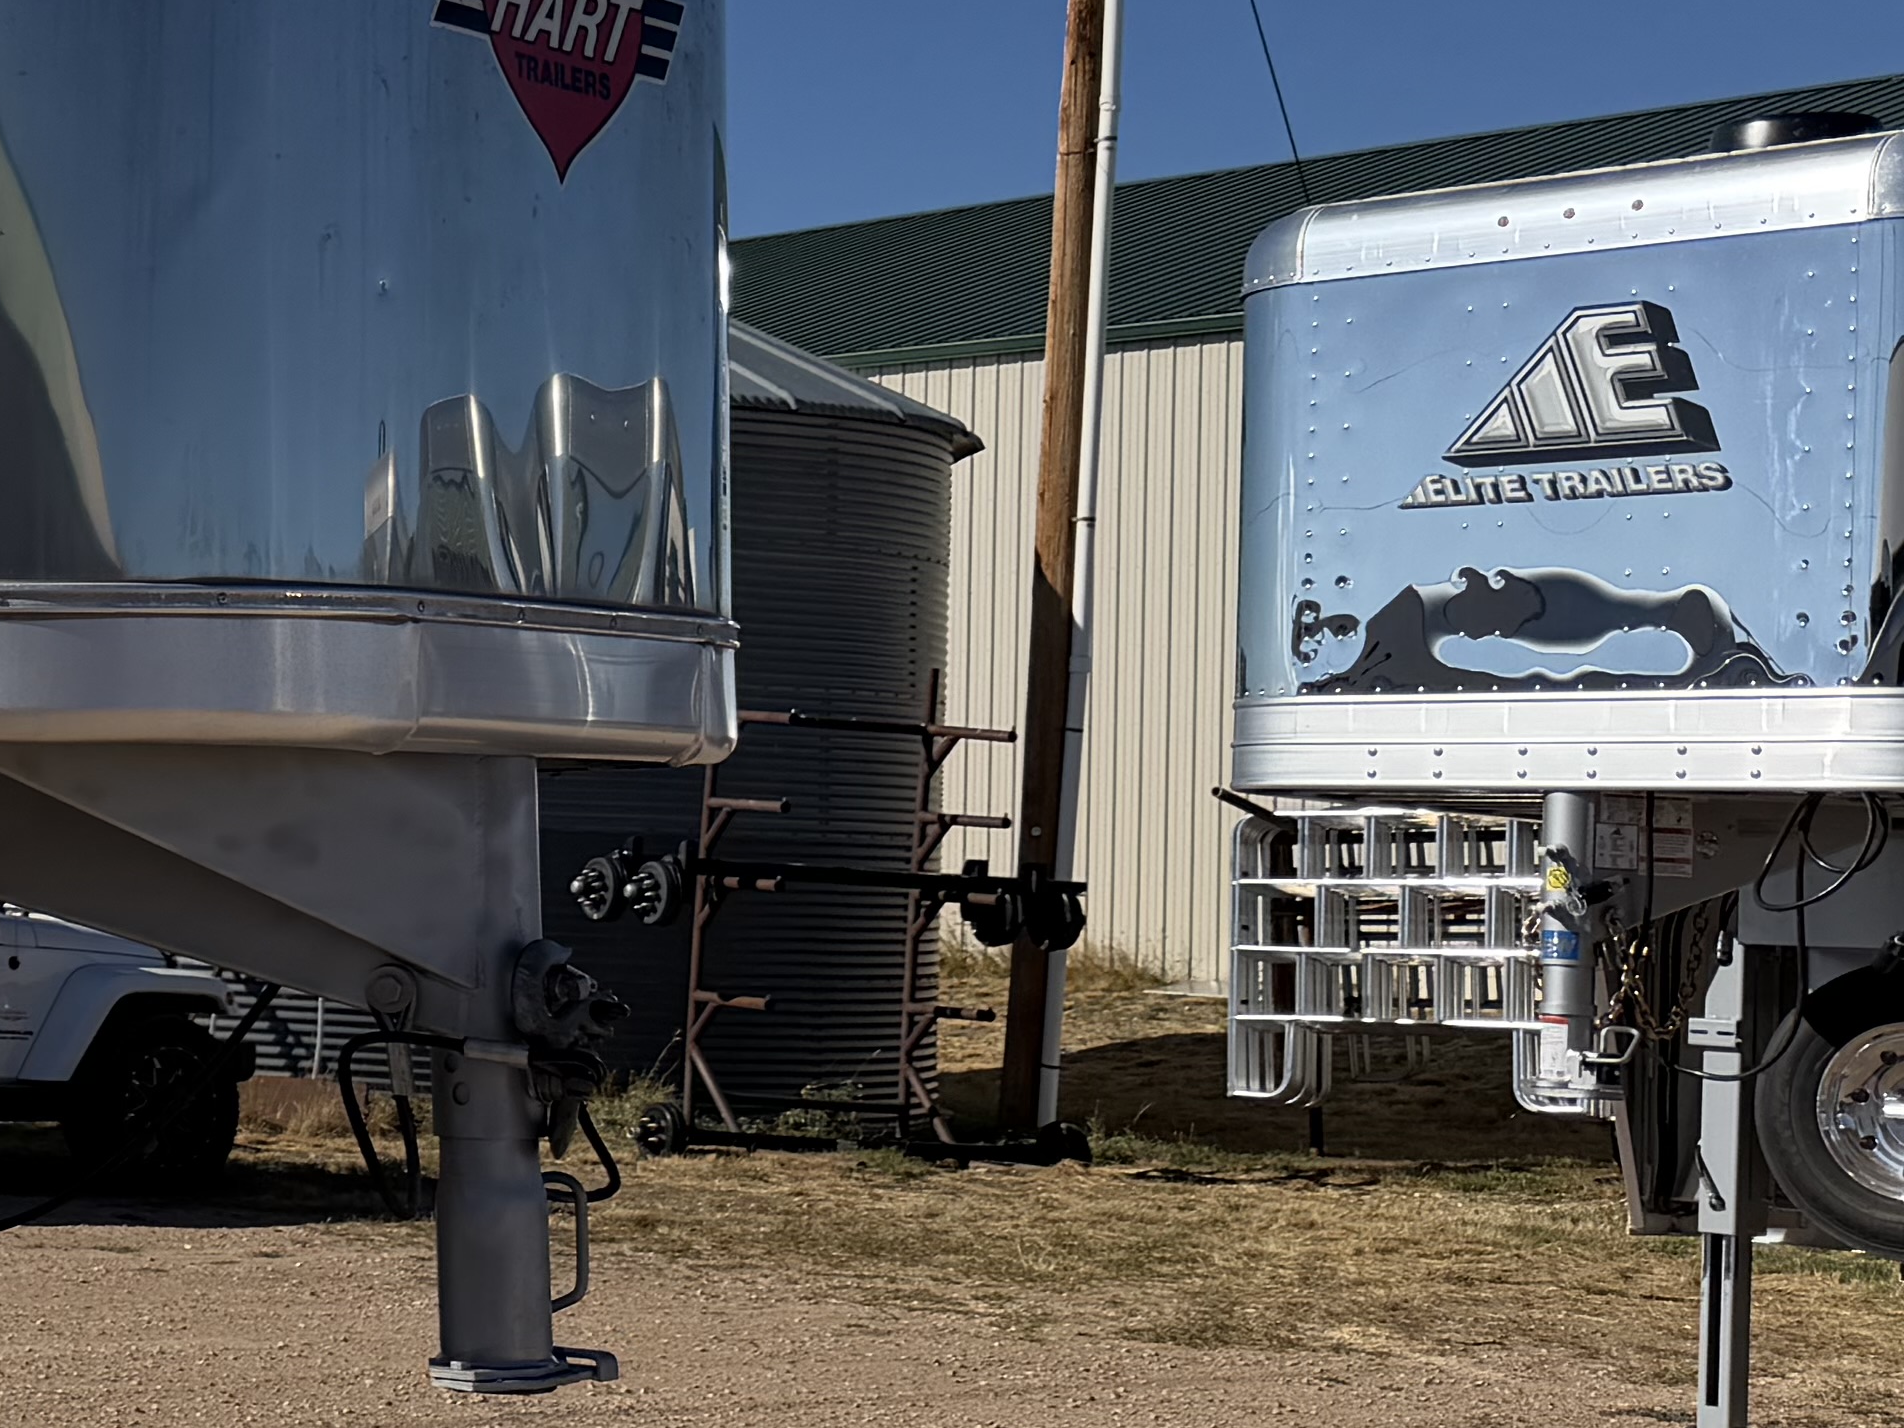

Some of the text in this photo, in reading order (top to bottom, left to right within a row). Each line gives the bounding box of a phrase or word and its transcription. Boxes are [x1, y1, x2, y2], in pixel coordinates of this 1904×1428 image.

[514, 51, 612, 101] TRAILERS
[1422, 461, 1733, 506] ELITE TRAILERS
